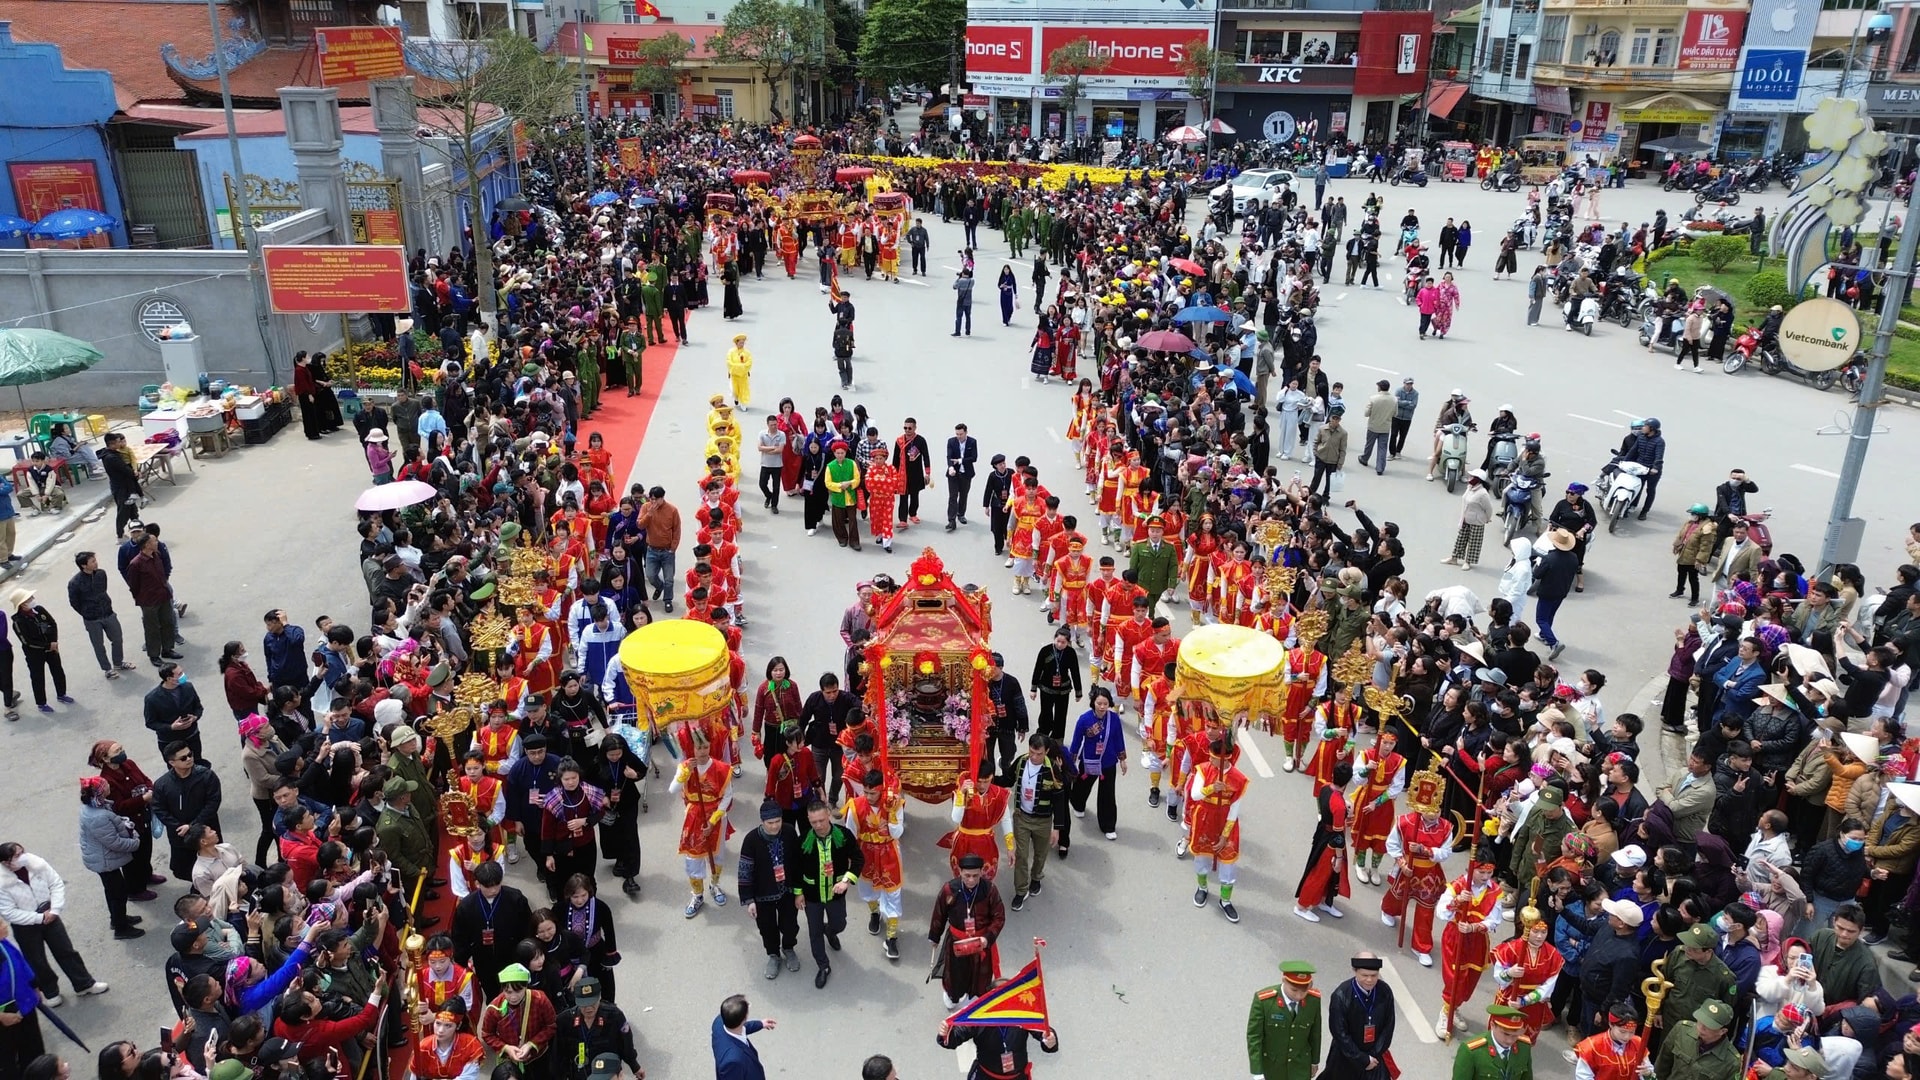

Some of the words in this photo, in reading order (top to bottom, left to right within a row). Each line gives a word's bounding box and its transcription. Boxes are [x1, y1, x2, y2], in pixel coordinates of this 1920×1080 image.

[1087, 40, 1164, 61] llphone
[1701, 46, 1715, 56] DẤU
[1258, 67, 1303, 83] KFC
[1747, 68, 1794, 83] IDOL
[1746, 84, 1794, 92] MOBILE
[1272, 120, 1285, 135] 11
[1785, 330, 1850, 351] Vietcombank
